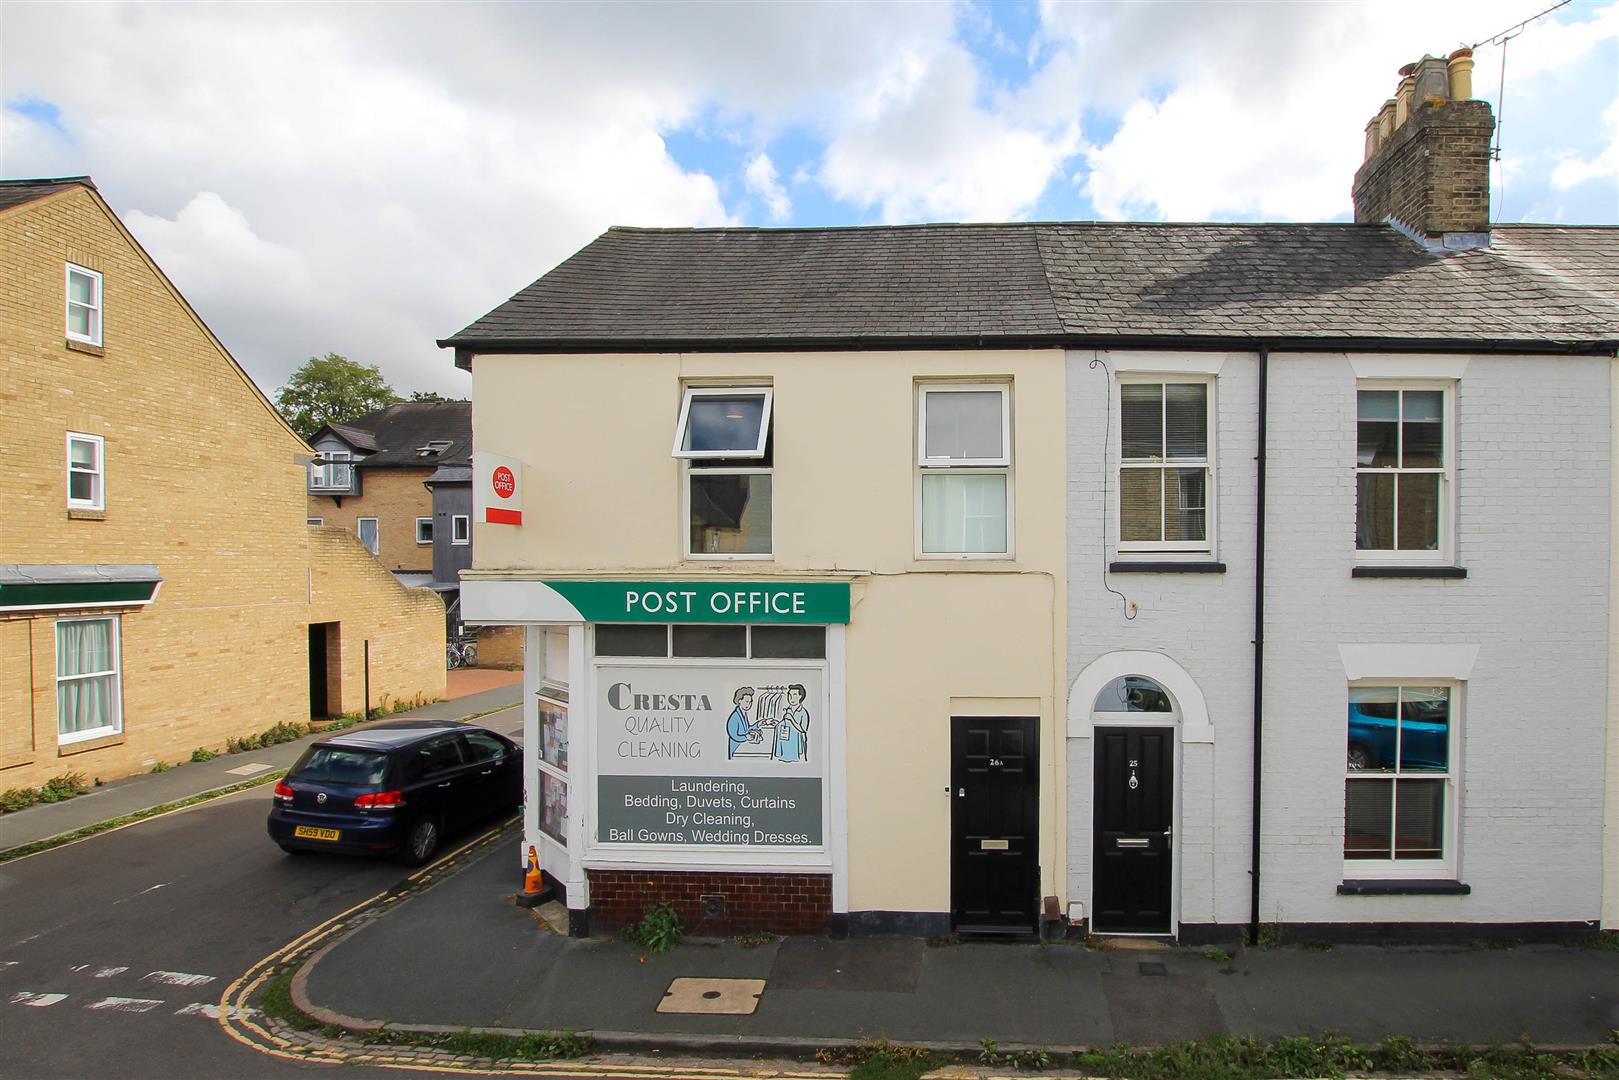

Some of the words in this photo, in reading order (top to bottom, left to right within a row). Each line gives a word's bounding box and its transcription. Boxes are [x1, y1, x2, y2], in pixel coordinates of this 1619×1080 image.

[497, 472, 510, 482] POST
[494, 481, 513, 491] OFFICE
[626, 591, 697, 613] POST
[710, 591, 806, 614] OFFICE
[607, 682, 712, 712] CRESTA
[624, 716, 694, 735] QUALITY
[617, 741, 701, 759] CLEANING
[671, 780, 749, 795] Laundering,
[624, 795, 682, 810] Bedding,
[686, 797, 736, 810] Duvets,
[740, 797, 796, 809] Curtains
[666, 812, 689, 827] Dry
[692, 812, 755, 828] Cleaning,
[298, 827, 318, 837] SH59
[609, 829, 634, 841] Ball
[637, 830, 687, 843] Gowns,
[691, 830, 750, 845] Wedding
[754, 831, 812, 844] Dresses.
